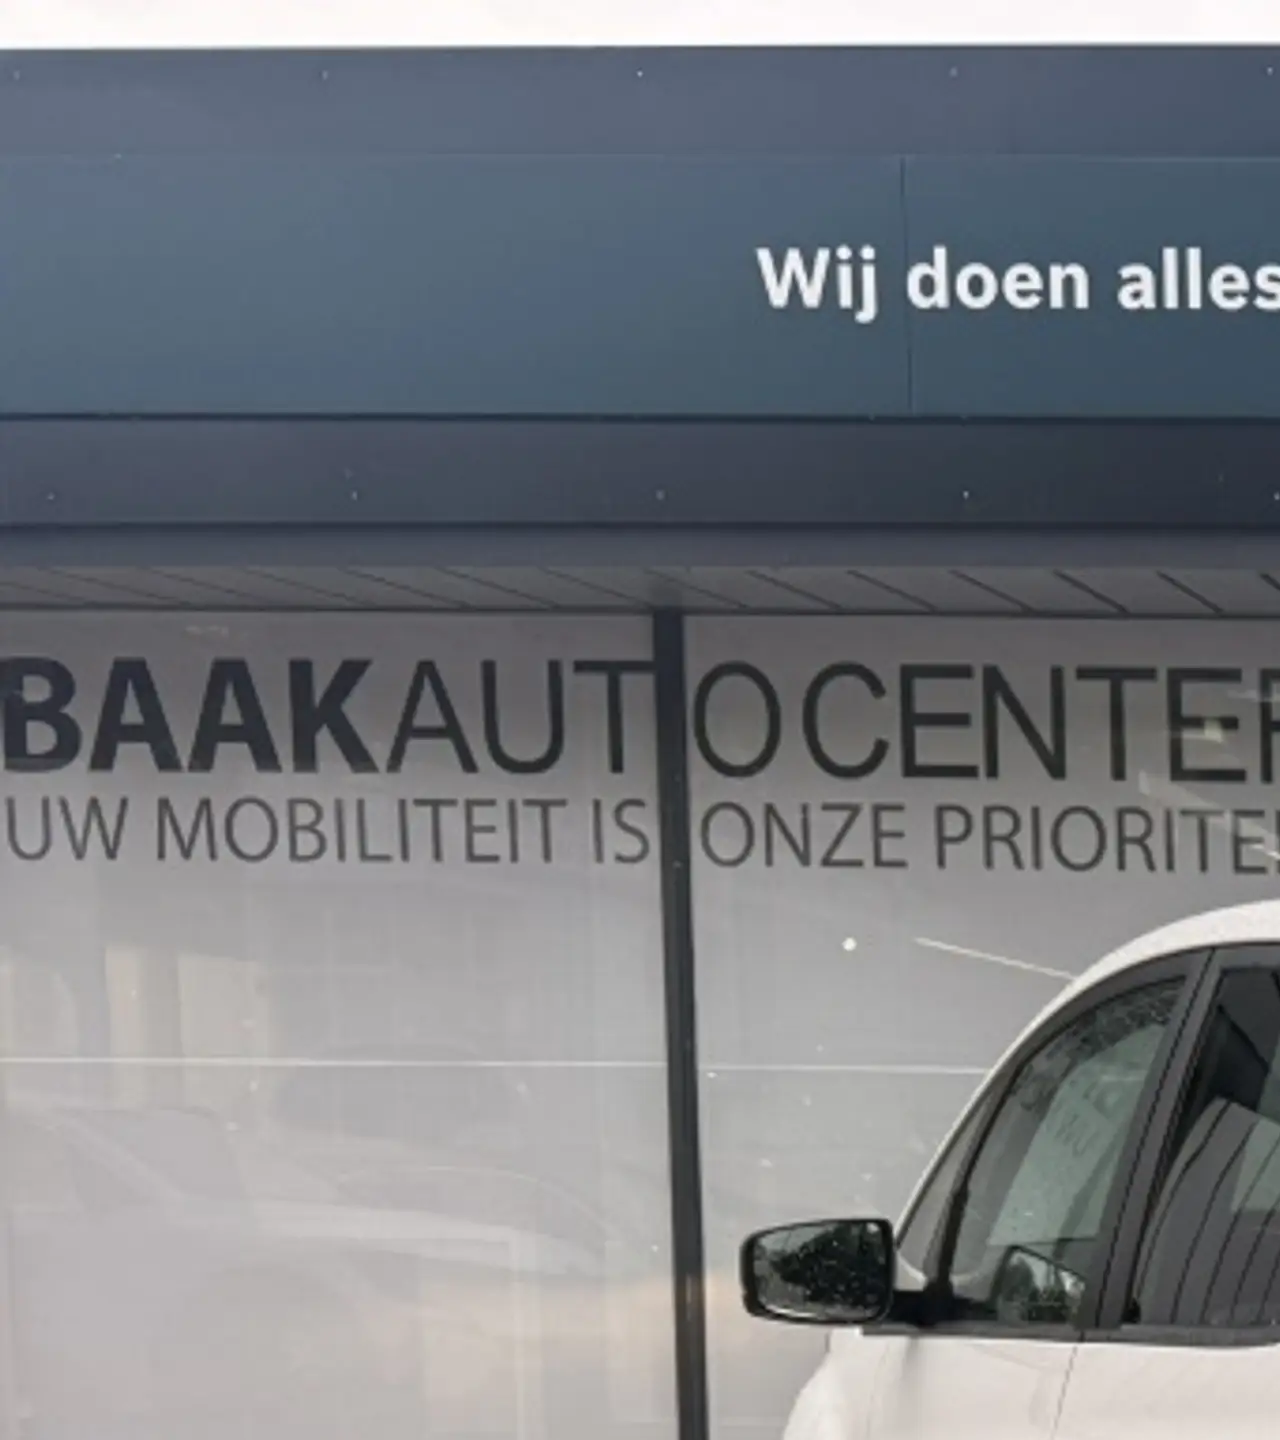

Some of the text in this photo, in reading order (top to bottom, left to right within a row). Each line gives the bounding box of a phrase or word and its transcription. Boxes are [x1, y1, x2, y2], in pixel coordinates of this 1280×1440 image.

[756, 246, 878, 324] Wij
[907, 245, 1090, 310] doen
[4, 796, 129, 861] UW
[157, 796, 568, 863] MOBILITEIT
[594, 798, 650, 864] IS
[699, 801, 908, 869] ONZE
